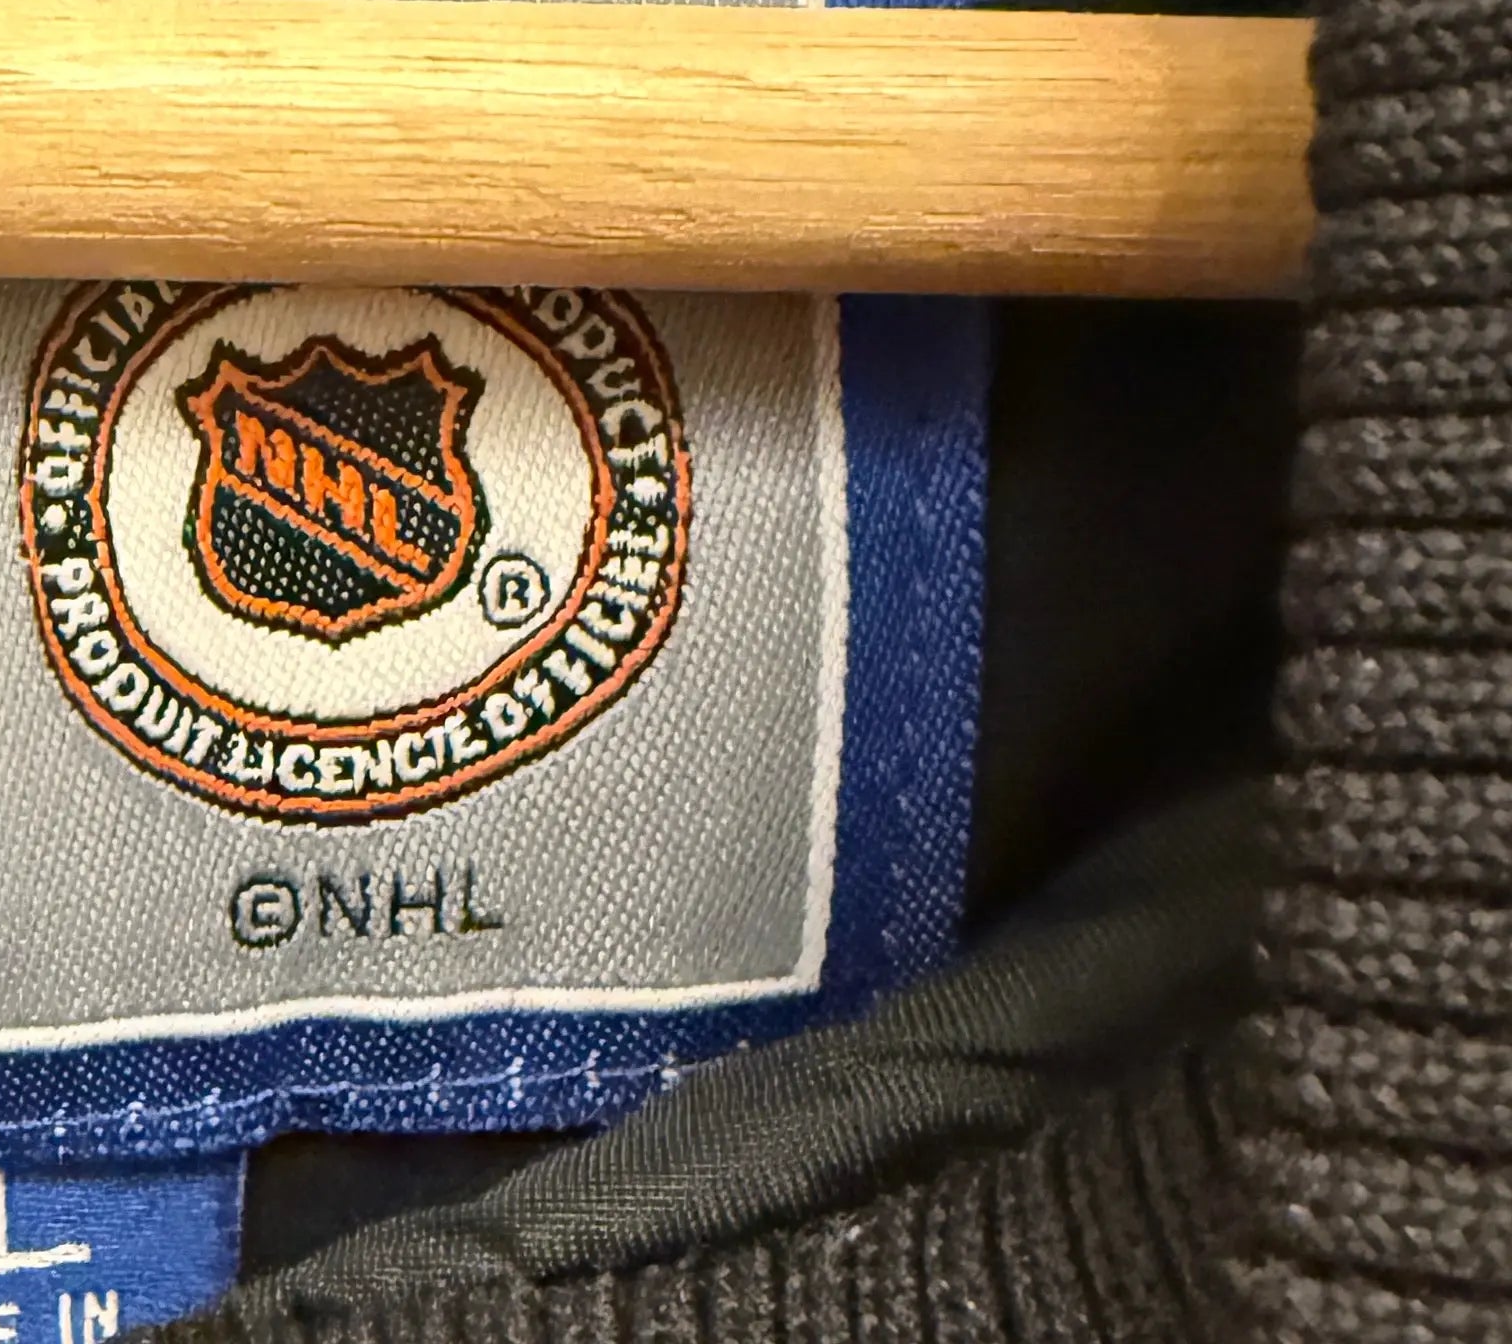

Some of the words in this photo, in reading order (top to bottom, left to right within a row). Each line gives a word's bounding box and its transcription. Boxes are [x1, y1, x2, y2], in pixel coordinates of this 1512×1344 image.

[502, 284, 669, 468] ODUCT
[233, 409, 431, 578] NHL
[40, 556, 223, 765] PRODUIT
[480, 522, 670, 741] OFFICIEL
[229, 864, 504, 949] ©NHL
